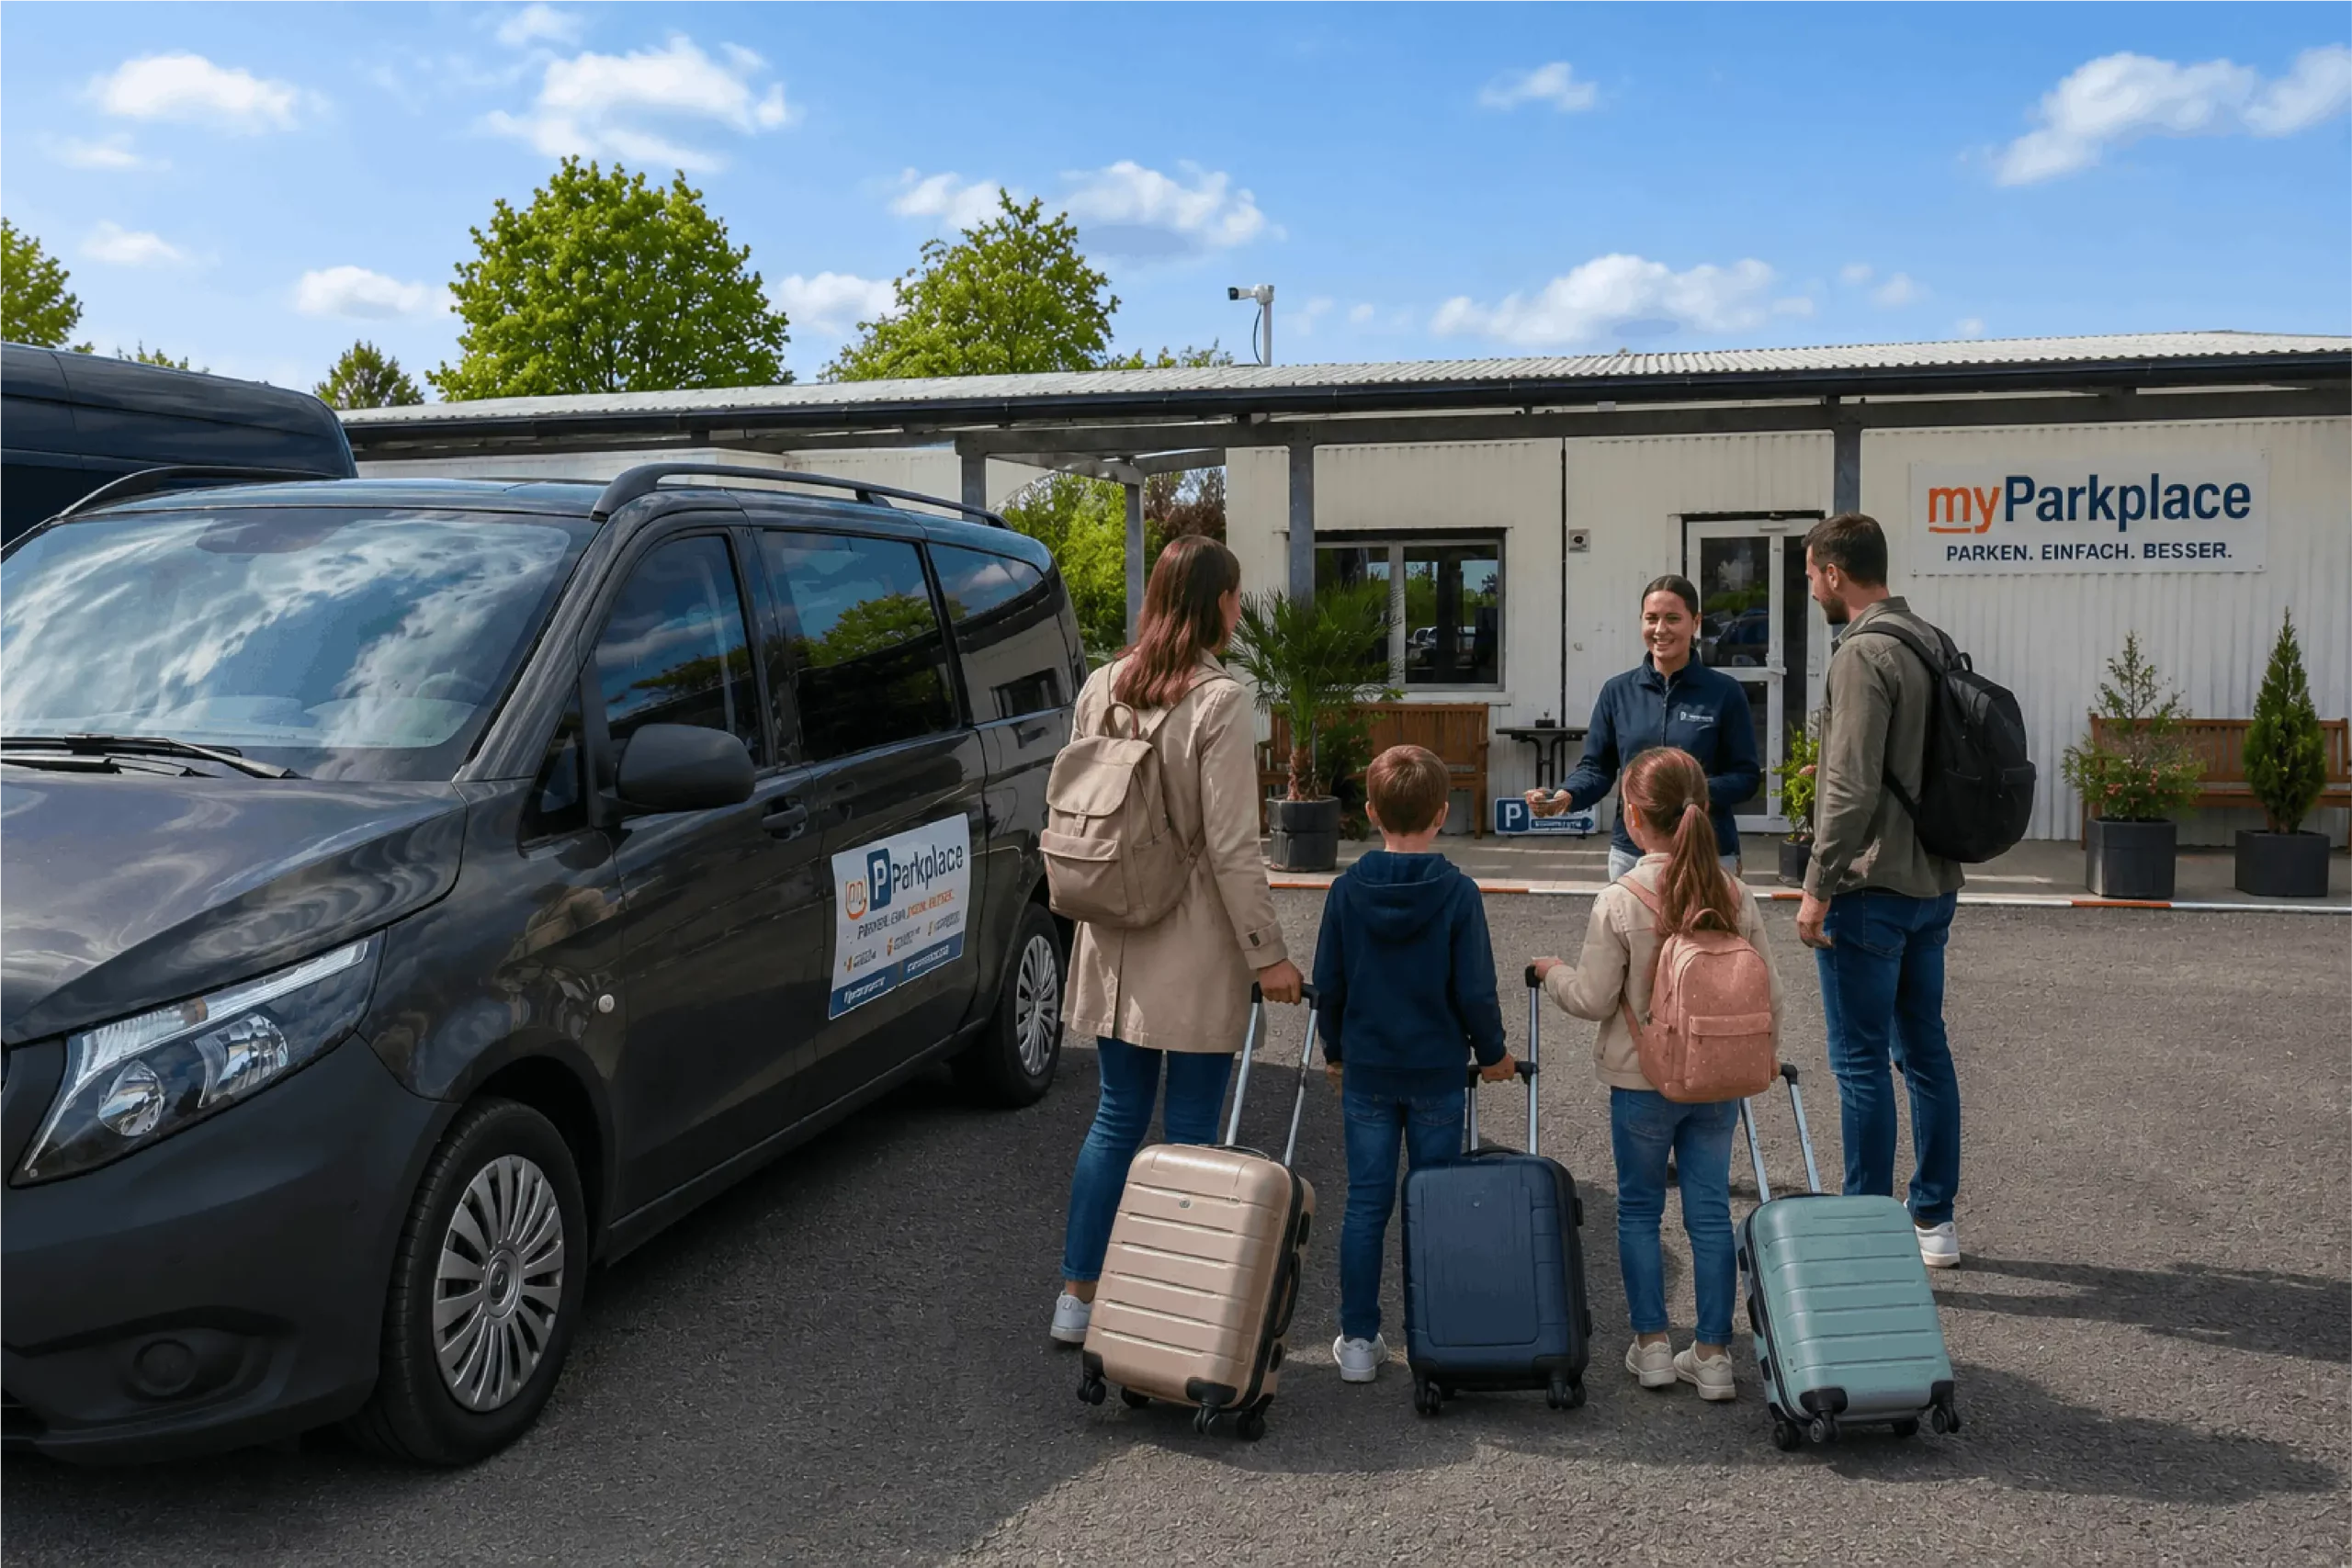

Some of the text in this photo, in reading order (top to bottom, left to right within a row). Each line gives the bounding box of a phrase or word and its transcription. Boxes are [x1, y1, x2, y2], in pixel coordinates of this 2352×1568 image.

[1928, 473, 2251, 534] myParkplace
[1946, 542, 2233, 561] PARKEN. EINFACH. BESSER.
[1505, 803, 1523, 828] P
